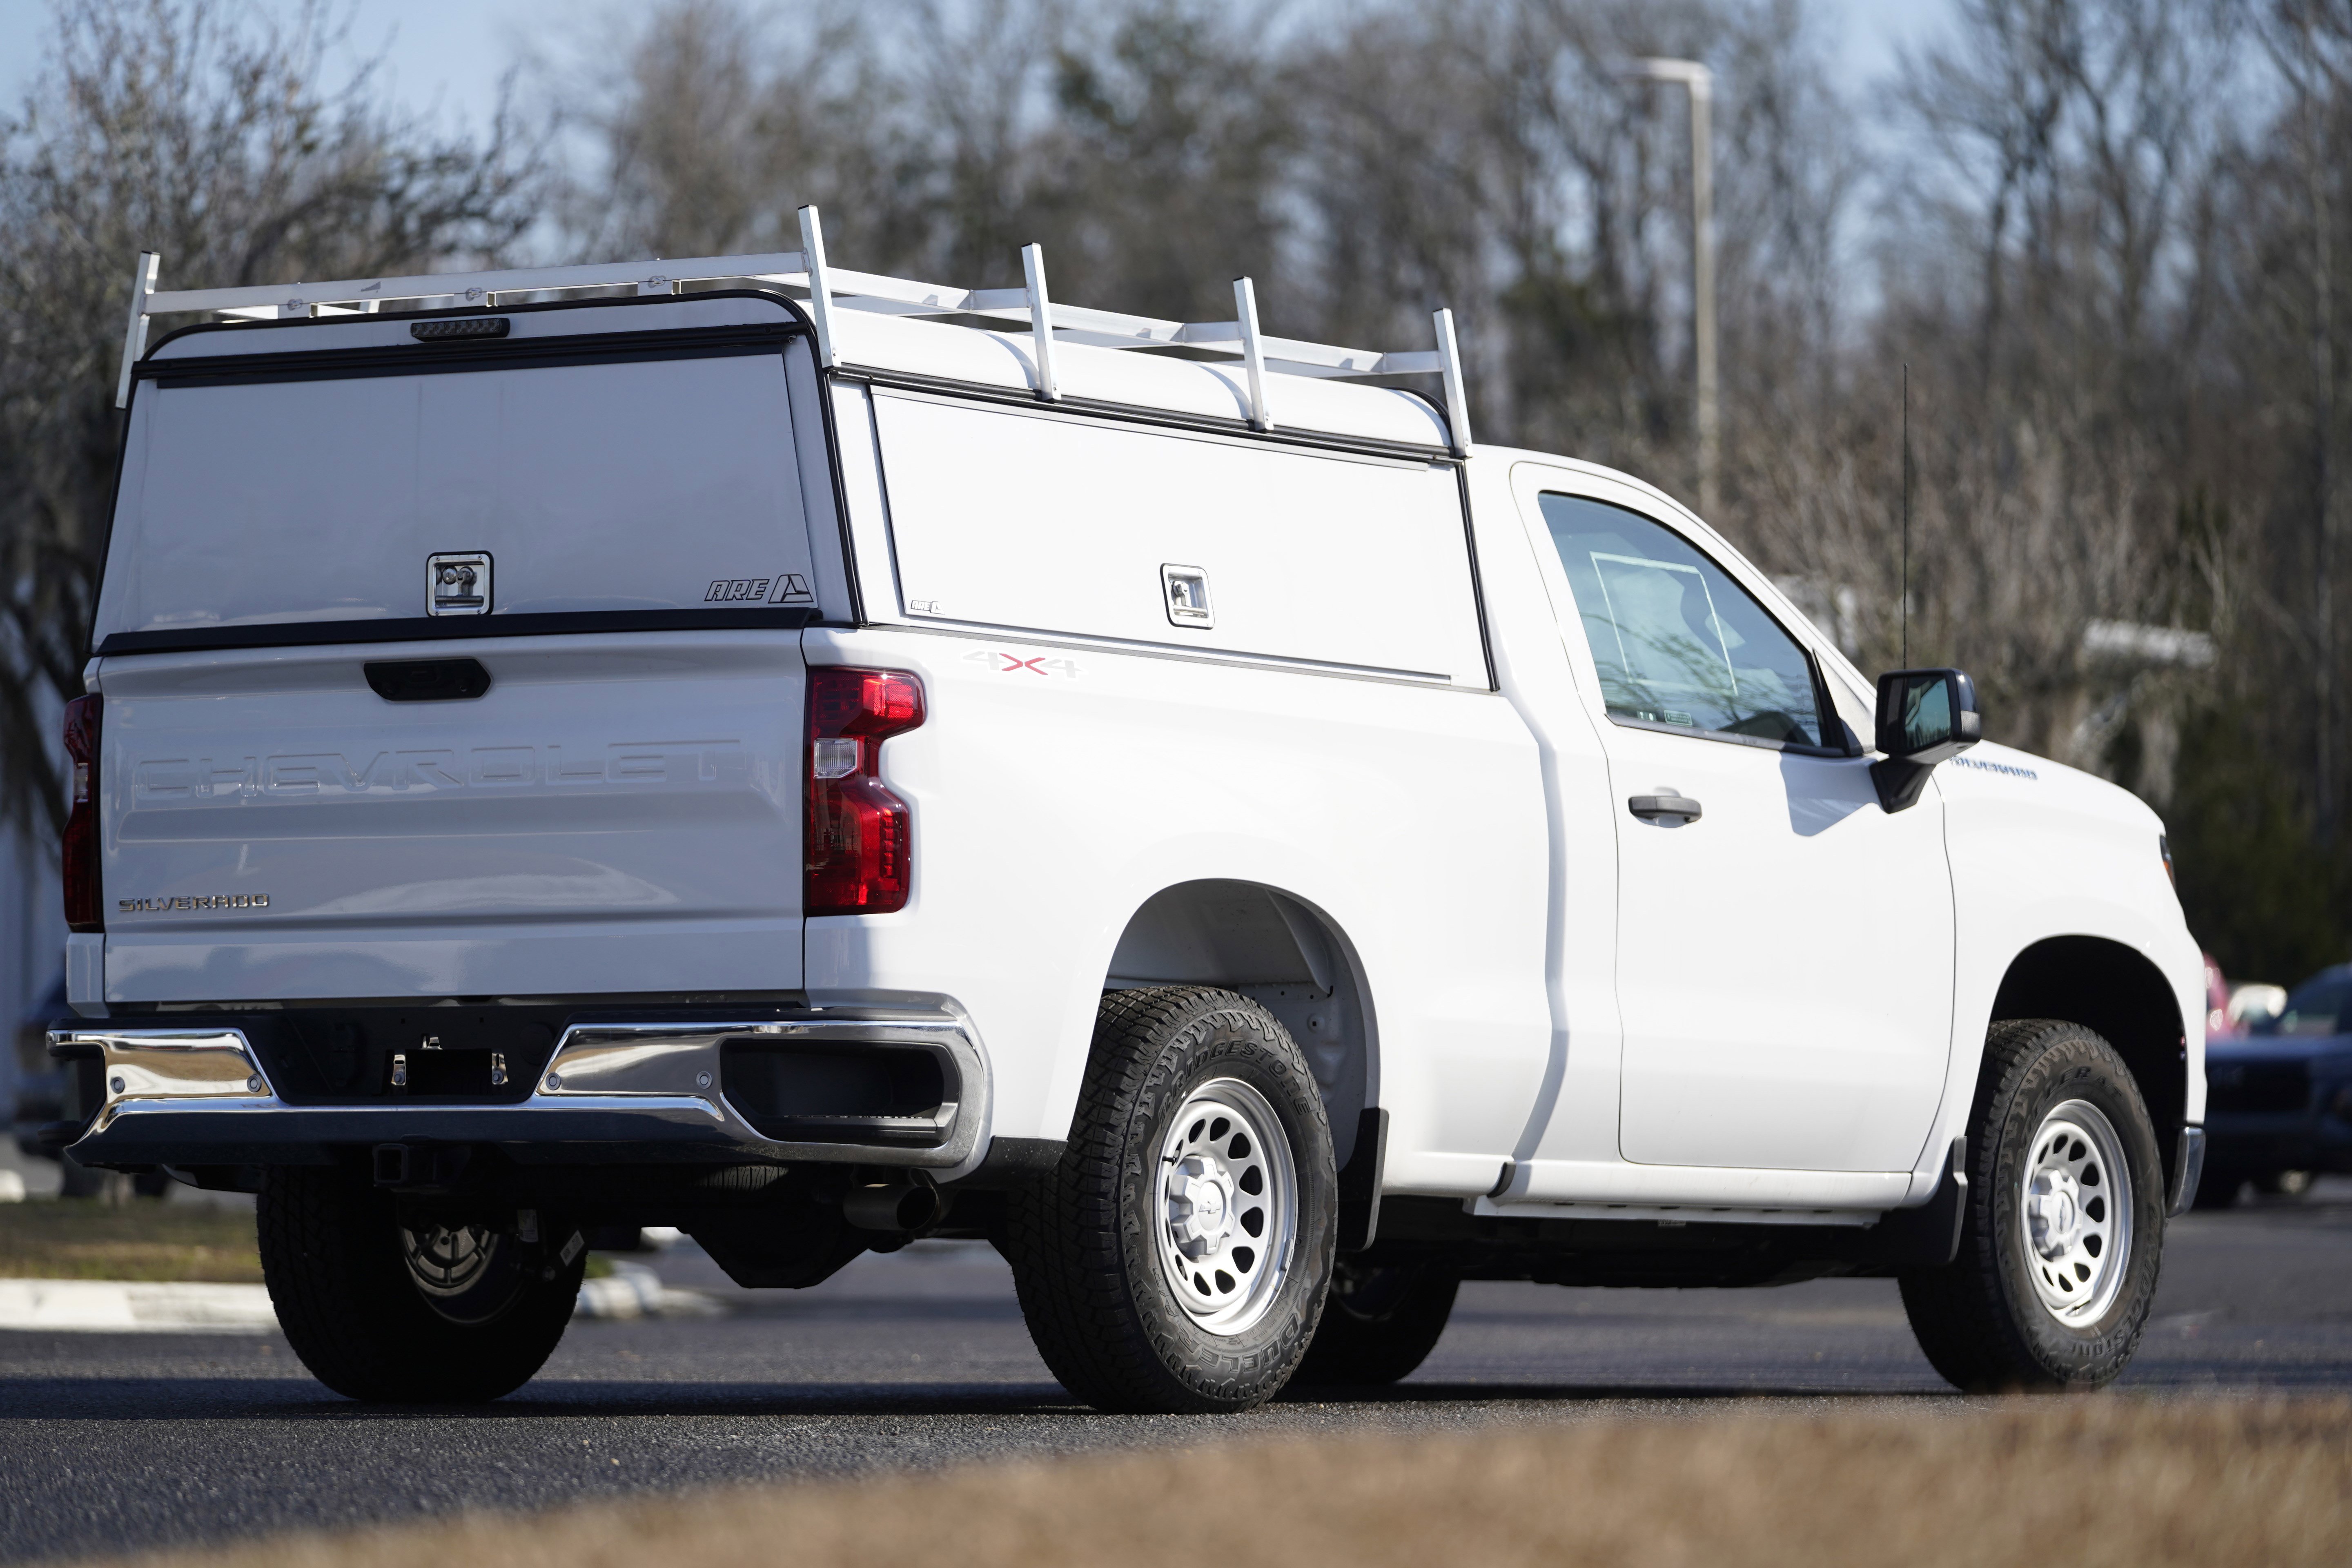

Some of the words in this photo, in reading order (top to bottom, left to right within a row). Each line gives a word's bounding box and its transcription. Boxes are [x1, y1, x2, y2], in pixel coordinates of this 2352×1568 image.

[704, 579, 770, 601] ARE
[911, 600, 931, 611] ARE
[137, 739, 747, 799] CHEVROLET
[119, 894, 269, 911] SILVERADO
[1158, 1036, 1312, 1130] BRIDGESTONE
[1178, 1312, 1301, 1373] DUELER
